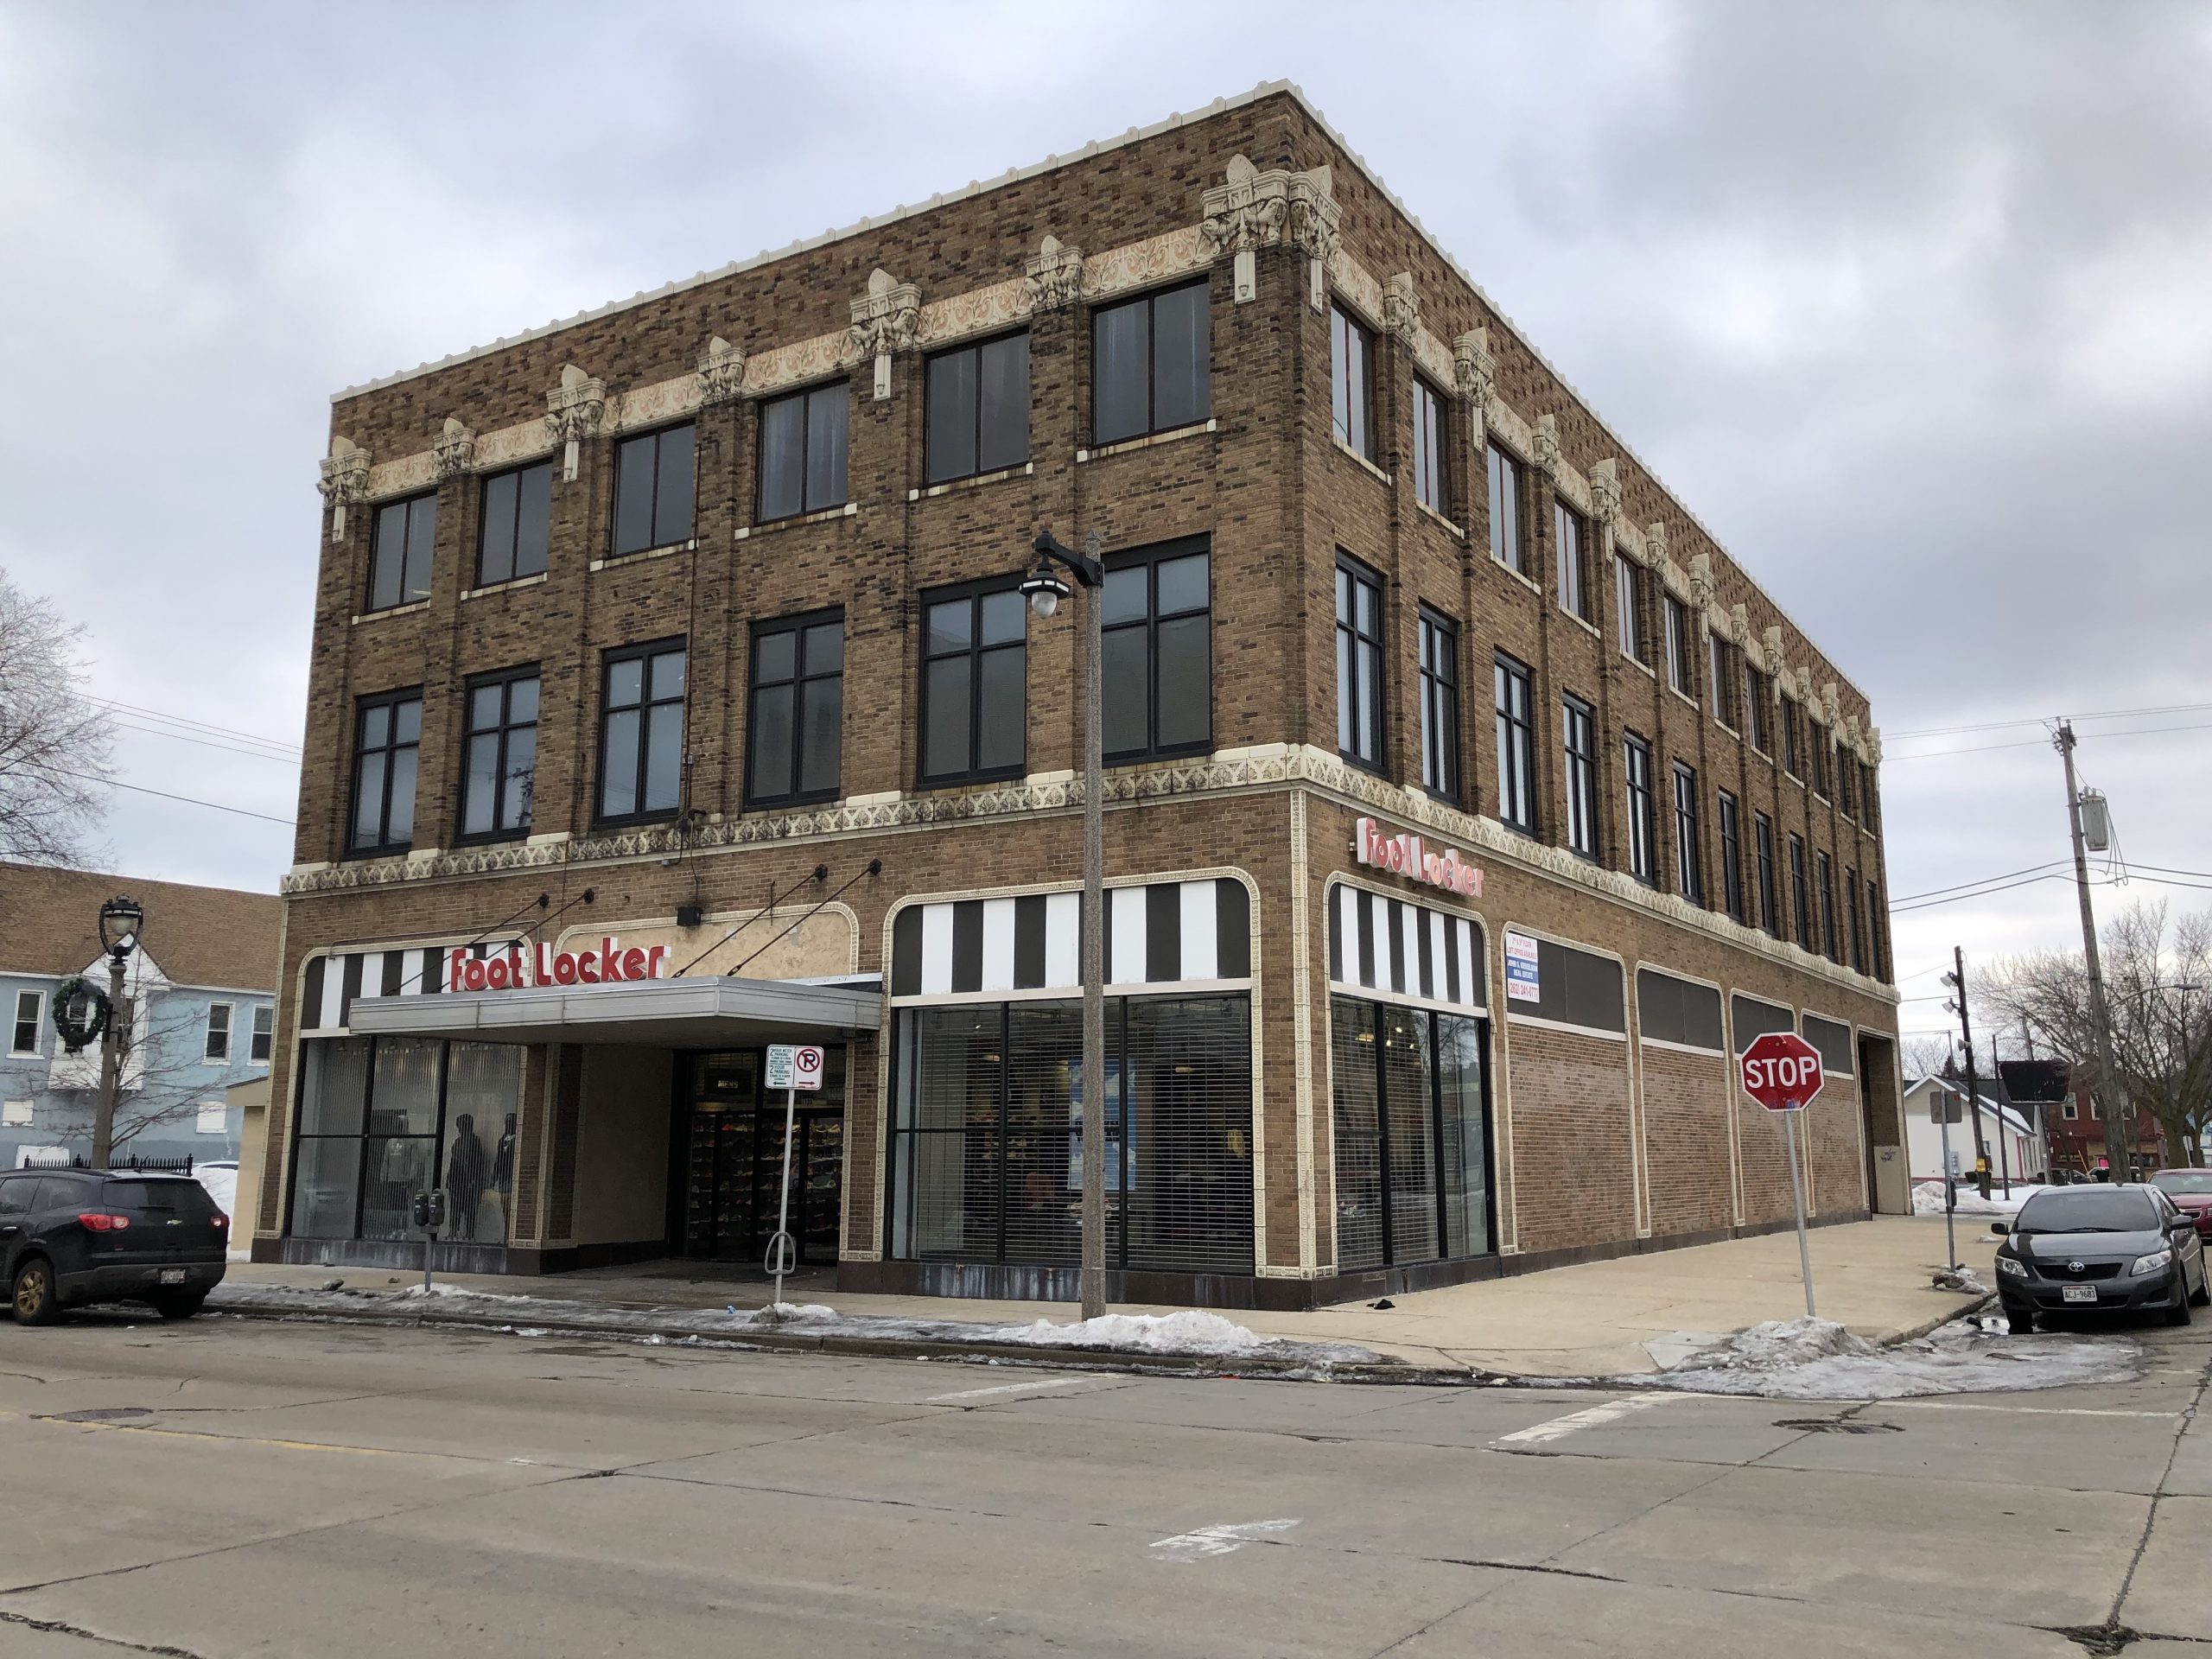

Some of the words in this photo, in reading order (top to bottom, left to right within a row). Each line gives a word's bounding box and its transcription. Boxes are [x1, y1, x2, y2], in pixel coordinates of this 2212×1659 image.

[450, 946, 527, 993] Foot
[534, 937, 670, 987] Locker
[769, 1065, 773, 1074] 2
[1745, 1056, 1817, 1089] STOP
